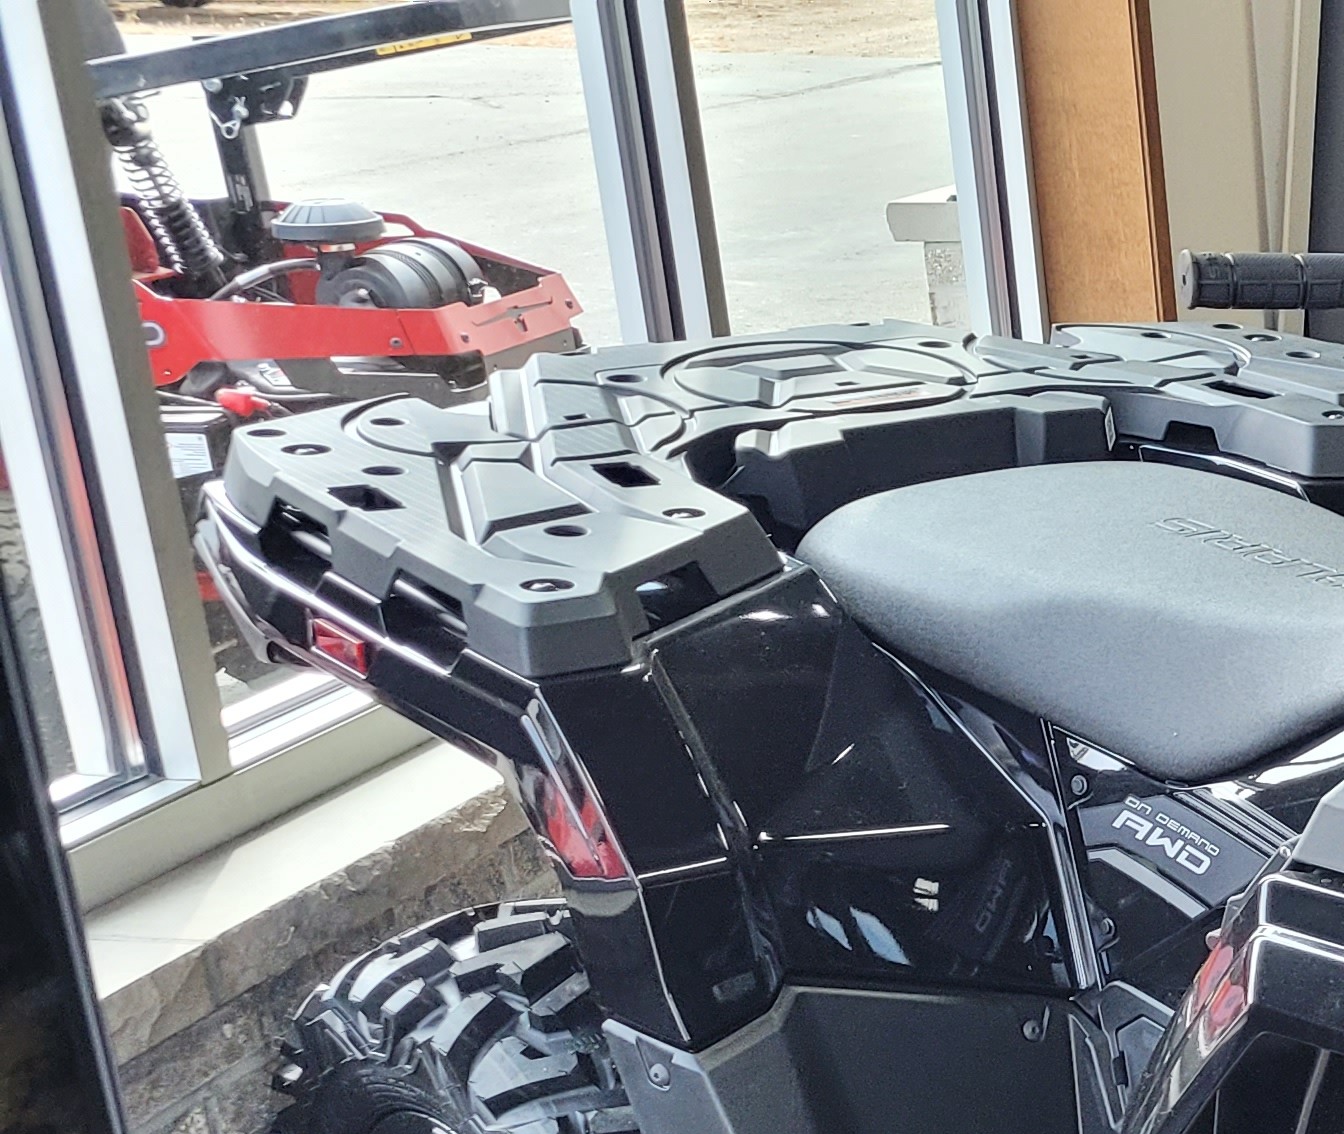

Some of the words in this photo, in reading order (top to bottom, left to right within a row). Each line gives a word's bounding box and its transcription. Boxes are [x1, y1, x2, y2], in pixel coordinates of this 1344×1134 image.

[1112, 809, 1212, 876] AWD
[1124, 795, 1153, 815] ON
[1155, 812, 1220, 857] DEMAND
